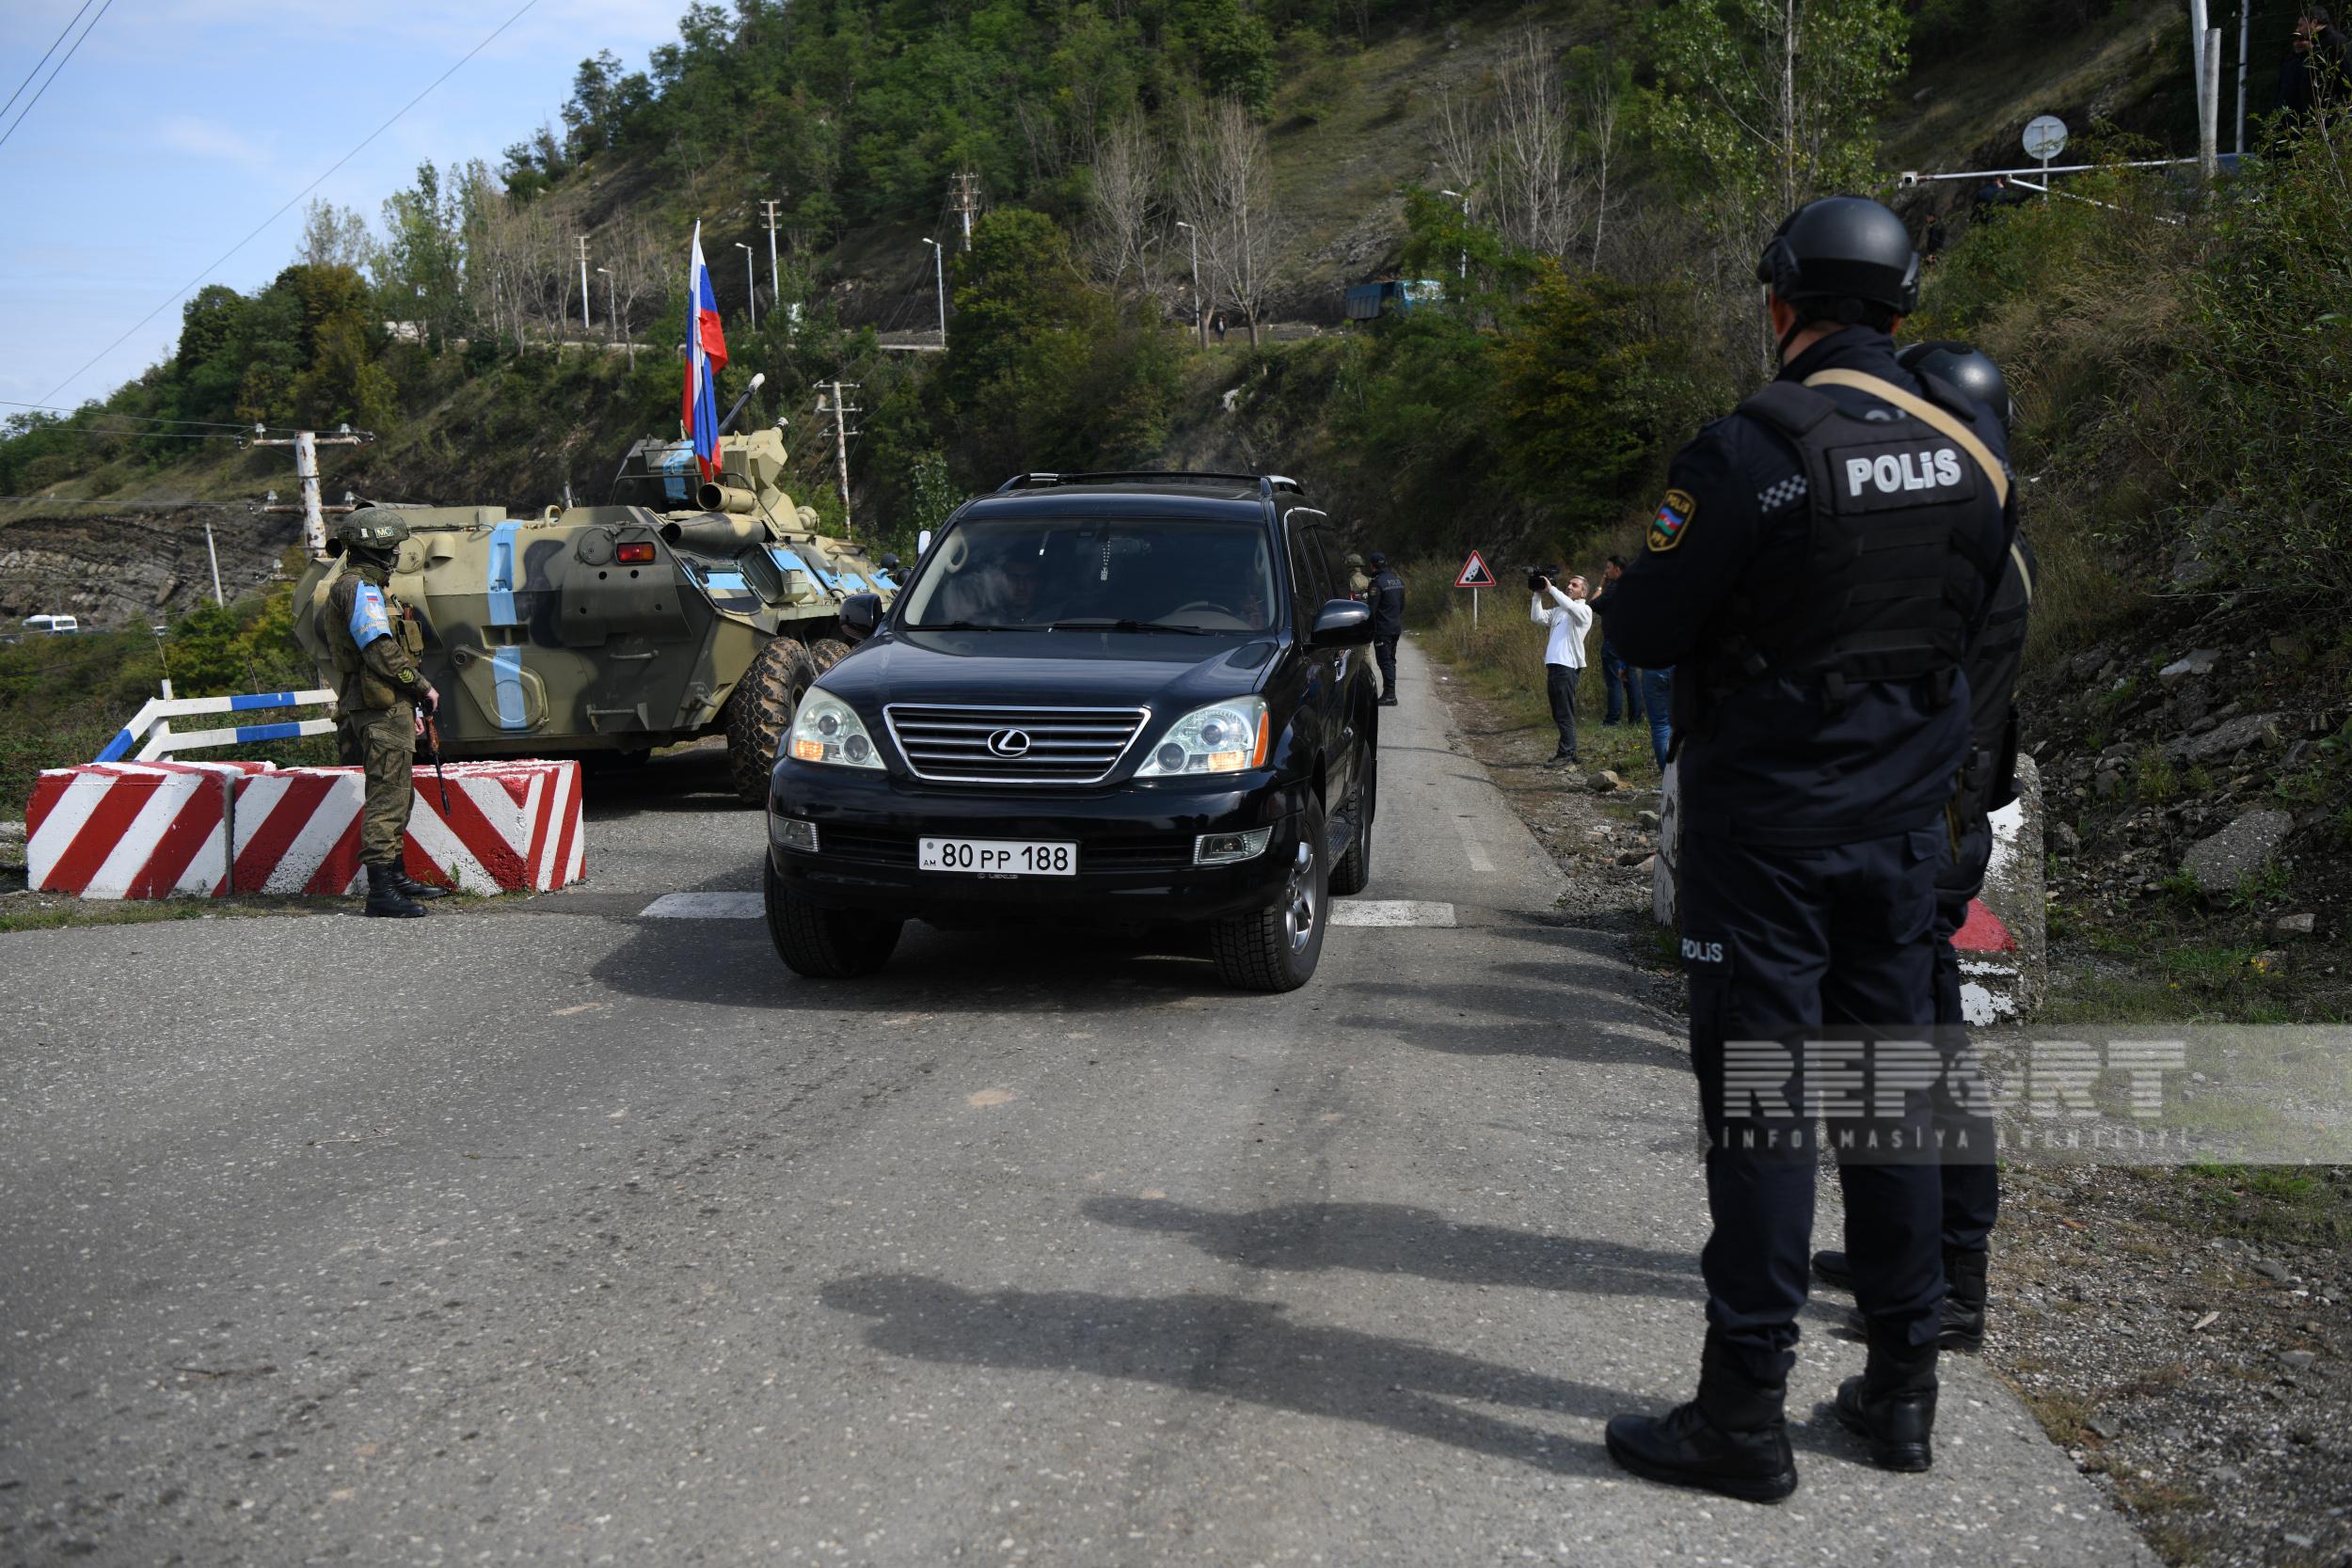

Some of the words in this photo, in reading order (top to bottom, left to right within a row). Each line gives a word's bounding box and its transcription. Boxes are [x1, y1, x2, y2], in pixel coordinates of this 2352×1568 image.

[942, 843, 973, 868] 80
[980, 850, 1011, 869] PP
[1021, 846, 1069, 871] 188
